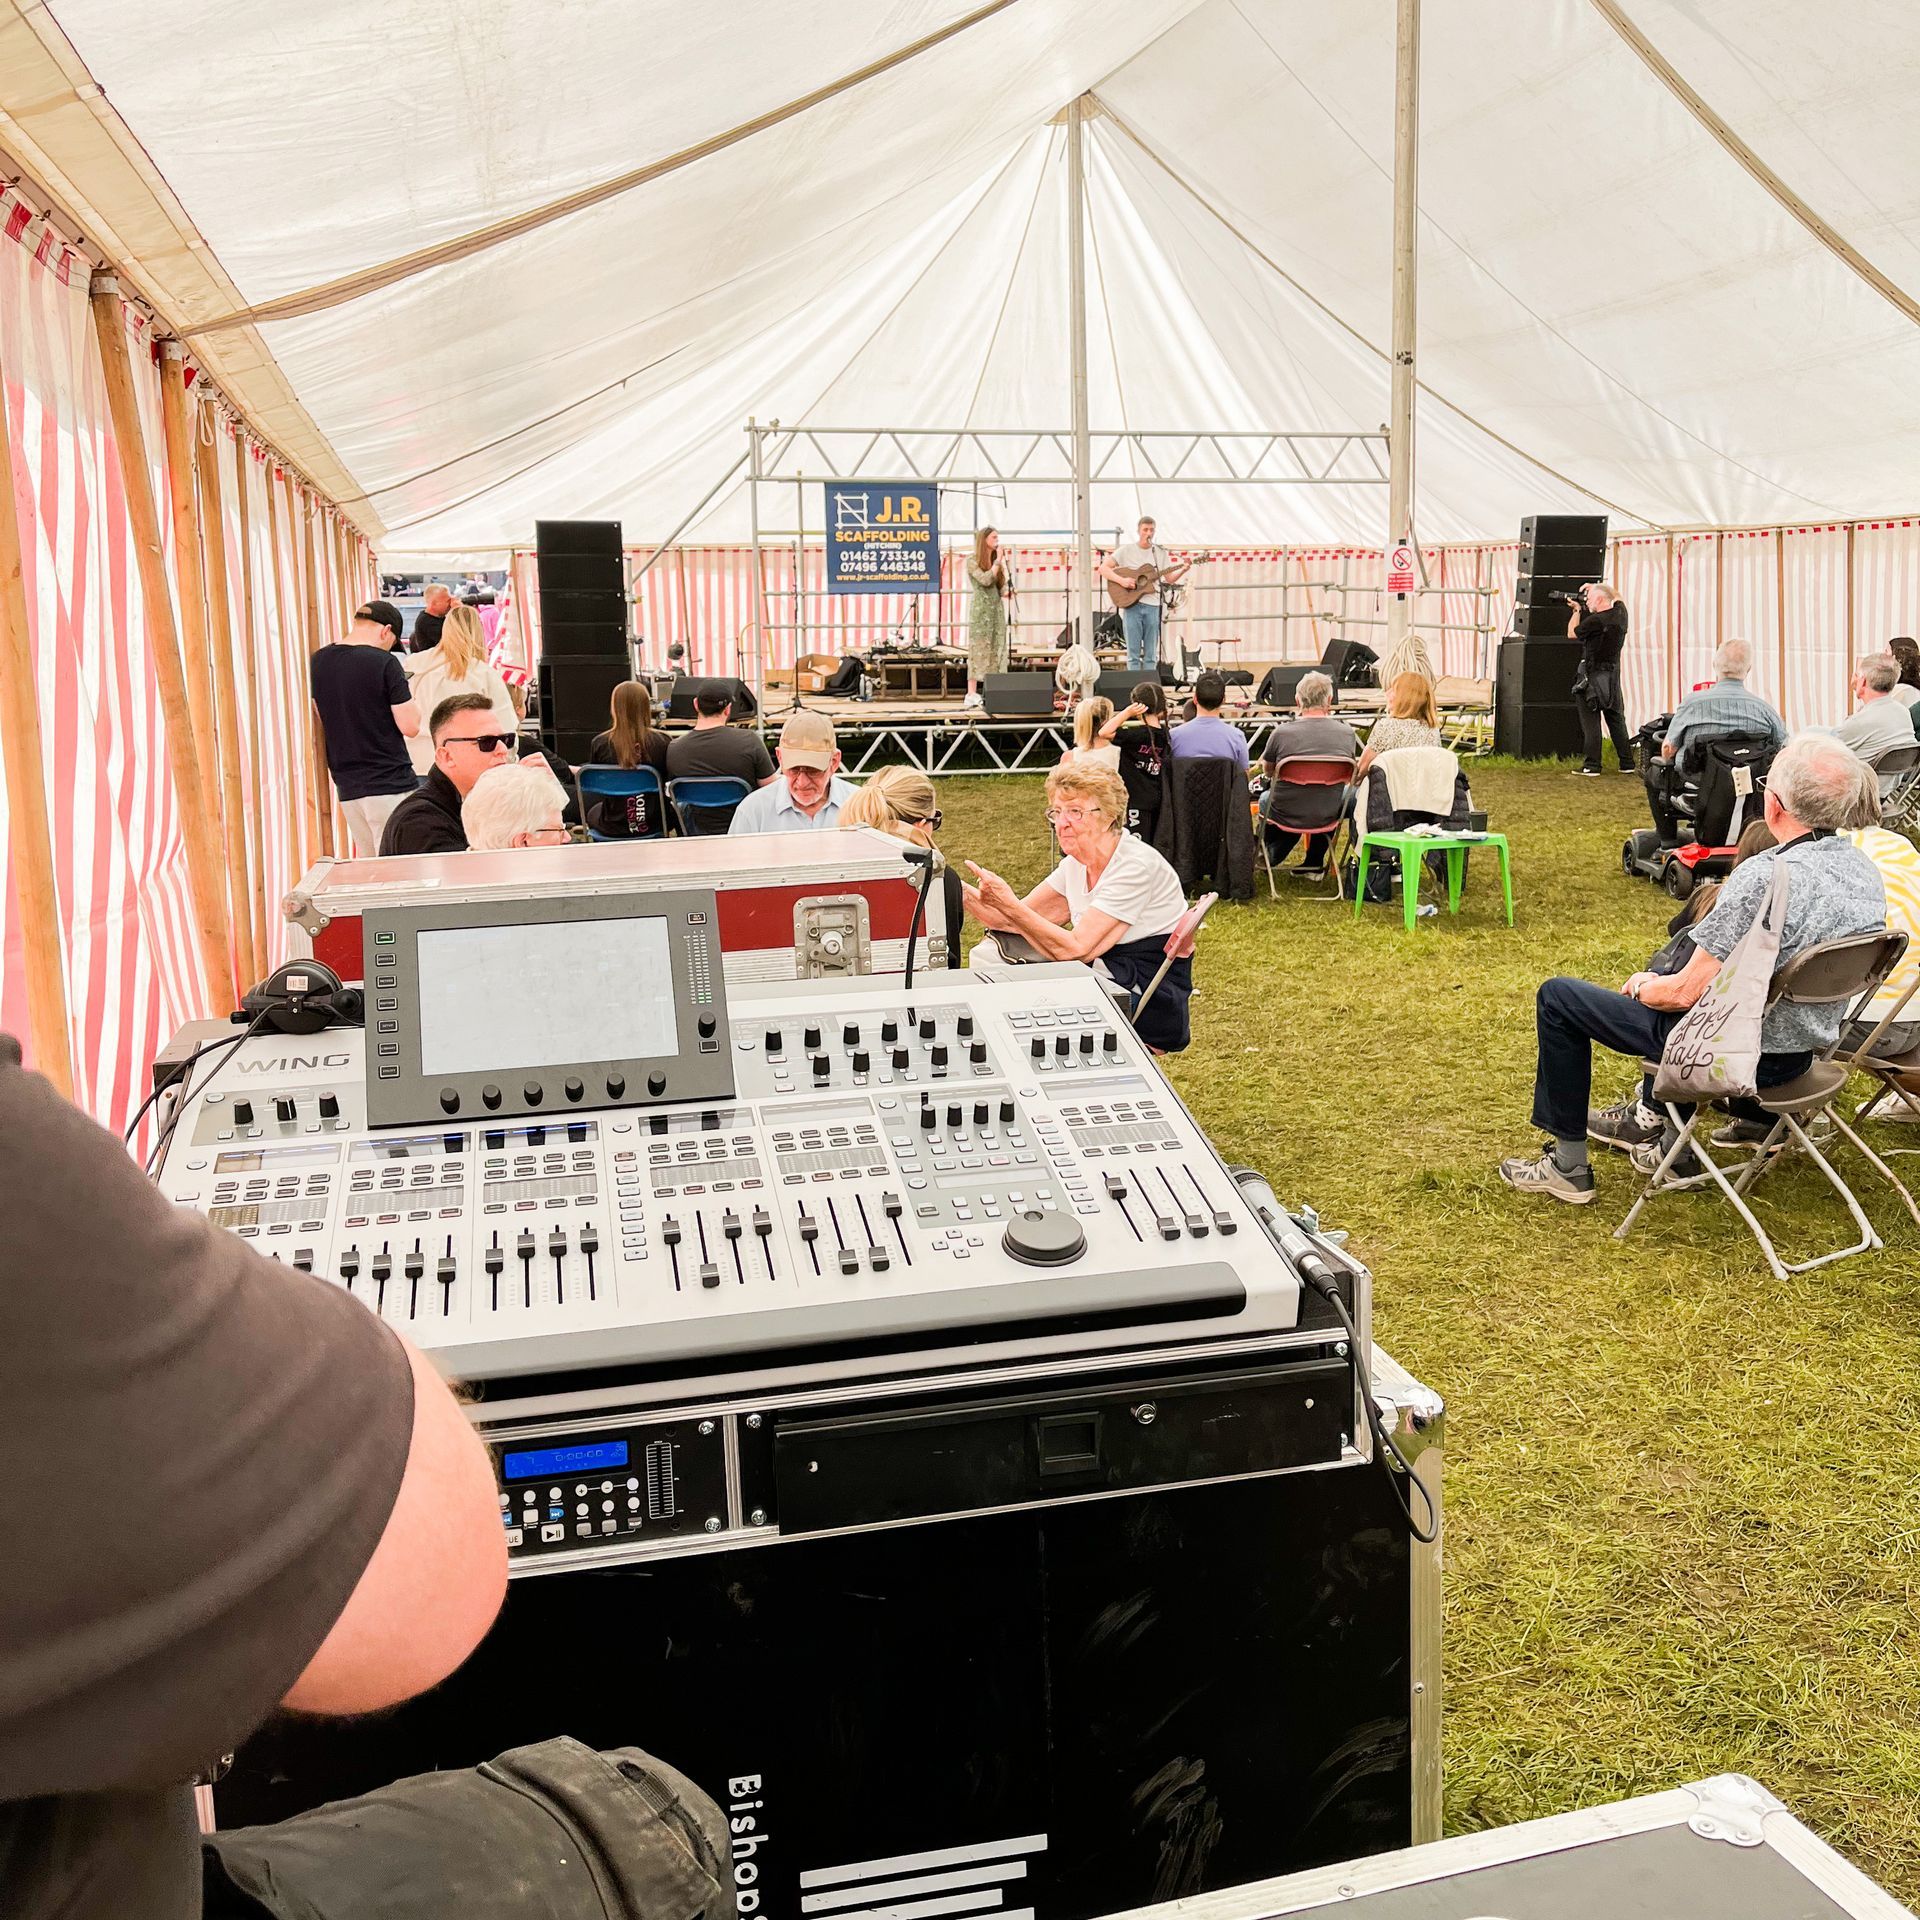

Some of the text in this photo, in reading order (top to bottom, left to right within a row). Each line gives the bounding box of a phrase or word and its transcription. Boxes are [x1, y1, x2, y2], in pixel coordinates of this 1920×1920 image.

[875, 496, 930, 523] J.R.
[835, 531, 930, 542] SCAFFOLDING
[840, 551, 926, 562] 01462 733340
[840, 562, 926, 573] 07496 446348
[836, 573, 930, 582] www.jr-scaffolding.co.uk
[236, 1053, 351, 1074] WING
[728, 1773, 769, 1920] Bishop
